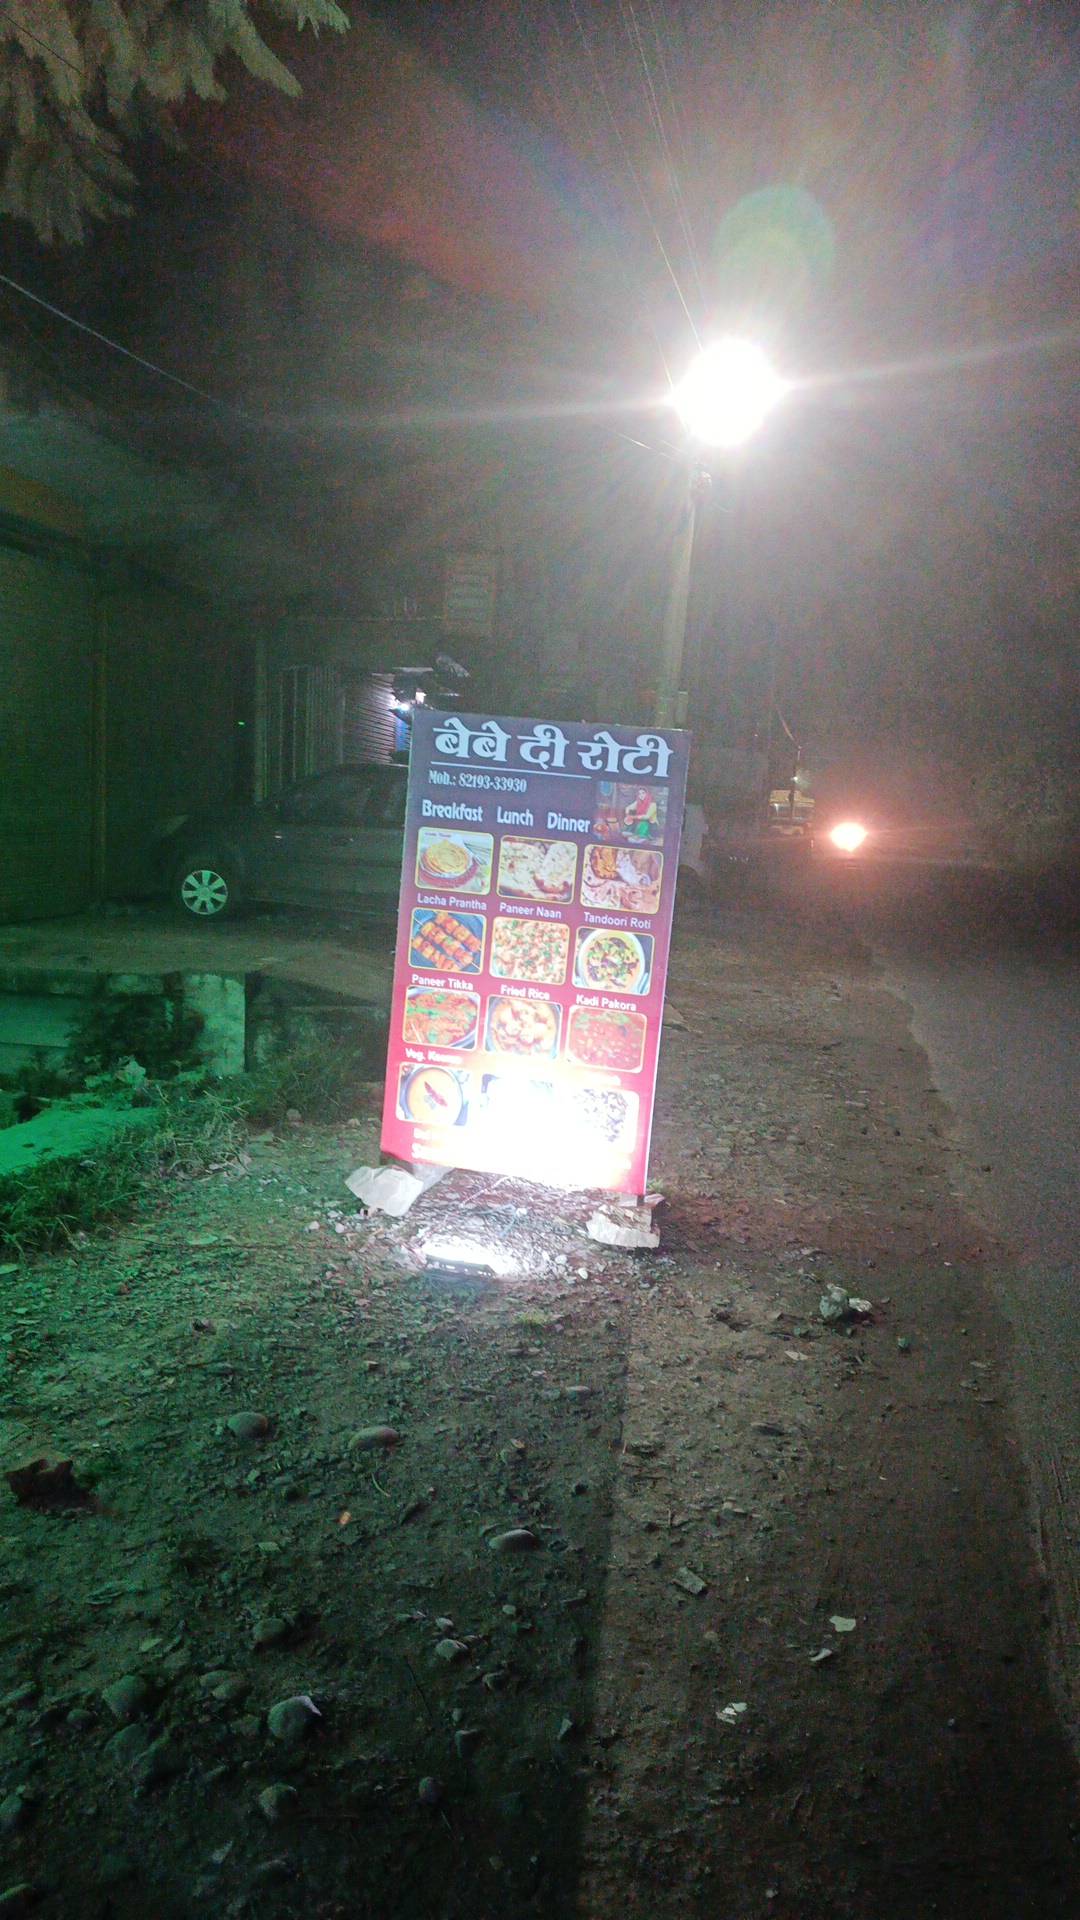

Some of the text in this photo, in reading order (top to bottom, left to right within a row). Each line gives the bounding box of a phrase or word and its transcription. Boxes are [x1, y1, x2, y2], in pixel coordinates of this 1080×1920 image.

[433, 717, 674, 777] बेबे दी रोटी
[459, 772, 527, 793] 82193-33930
[422, 799, 590, 834] Breakfast Lunch Dinner
[417, 893, 487, 911] Lacha Prantha
[499, 902, 562, 919] Paneer Naan
[583, 911, 651, 929] Tandoori Roti
[411, 974, 474, 991] Paneer Tikka
[500, 984, 550, 1001] Fried Rice
[601, 997, 637, 1012] Pakora
